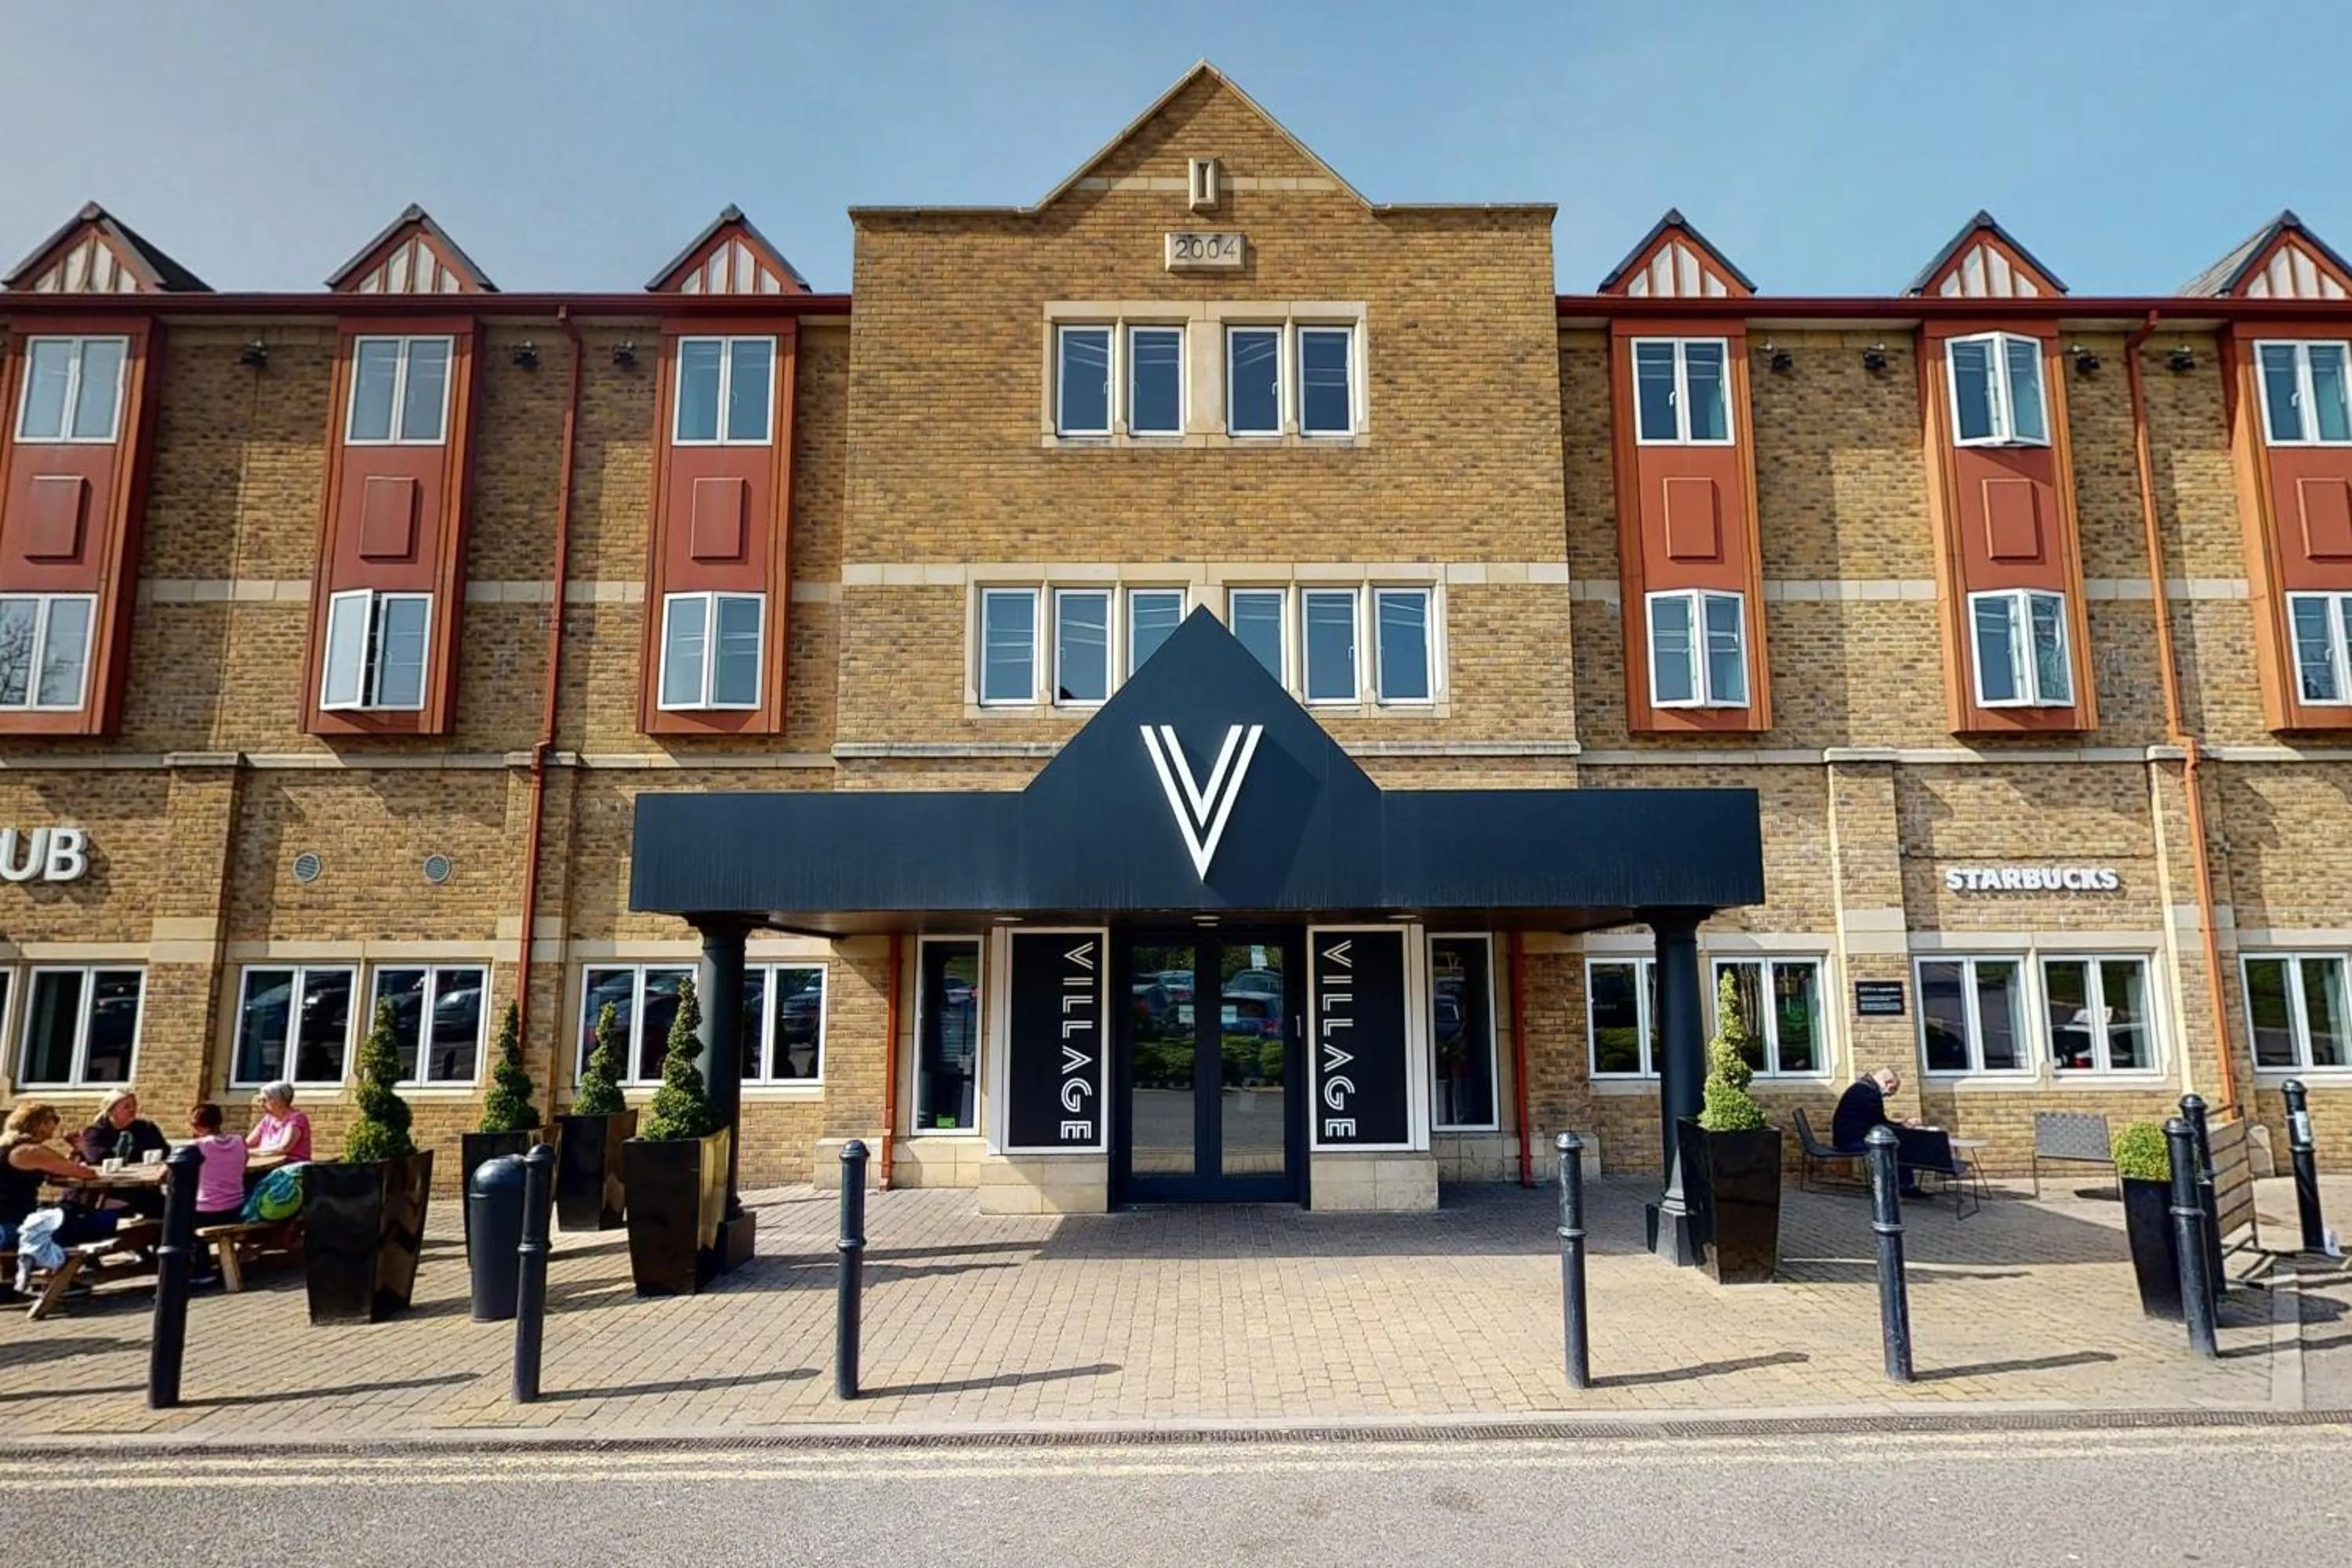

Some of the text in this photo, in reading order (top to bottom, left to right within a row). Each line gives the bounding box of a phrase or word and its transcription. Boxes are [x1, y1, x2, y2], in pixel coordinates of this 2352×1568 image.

[1175, 238, 1236, 260] 2004
[0, 827, 87, 880] UB
[1139, 724, 1264, 883] V
[1944, 867, 2118, 891] STARBUCKS
[1061, 941, 1094, 1139] VILLAGE
[1323, 940, 1356, 1138] VILLAGE
